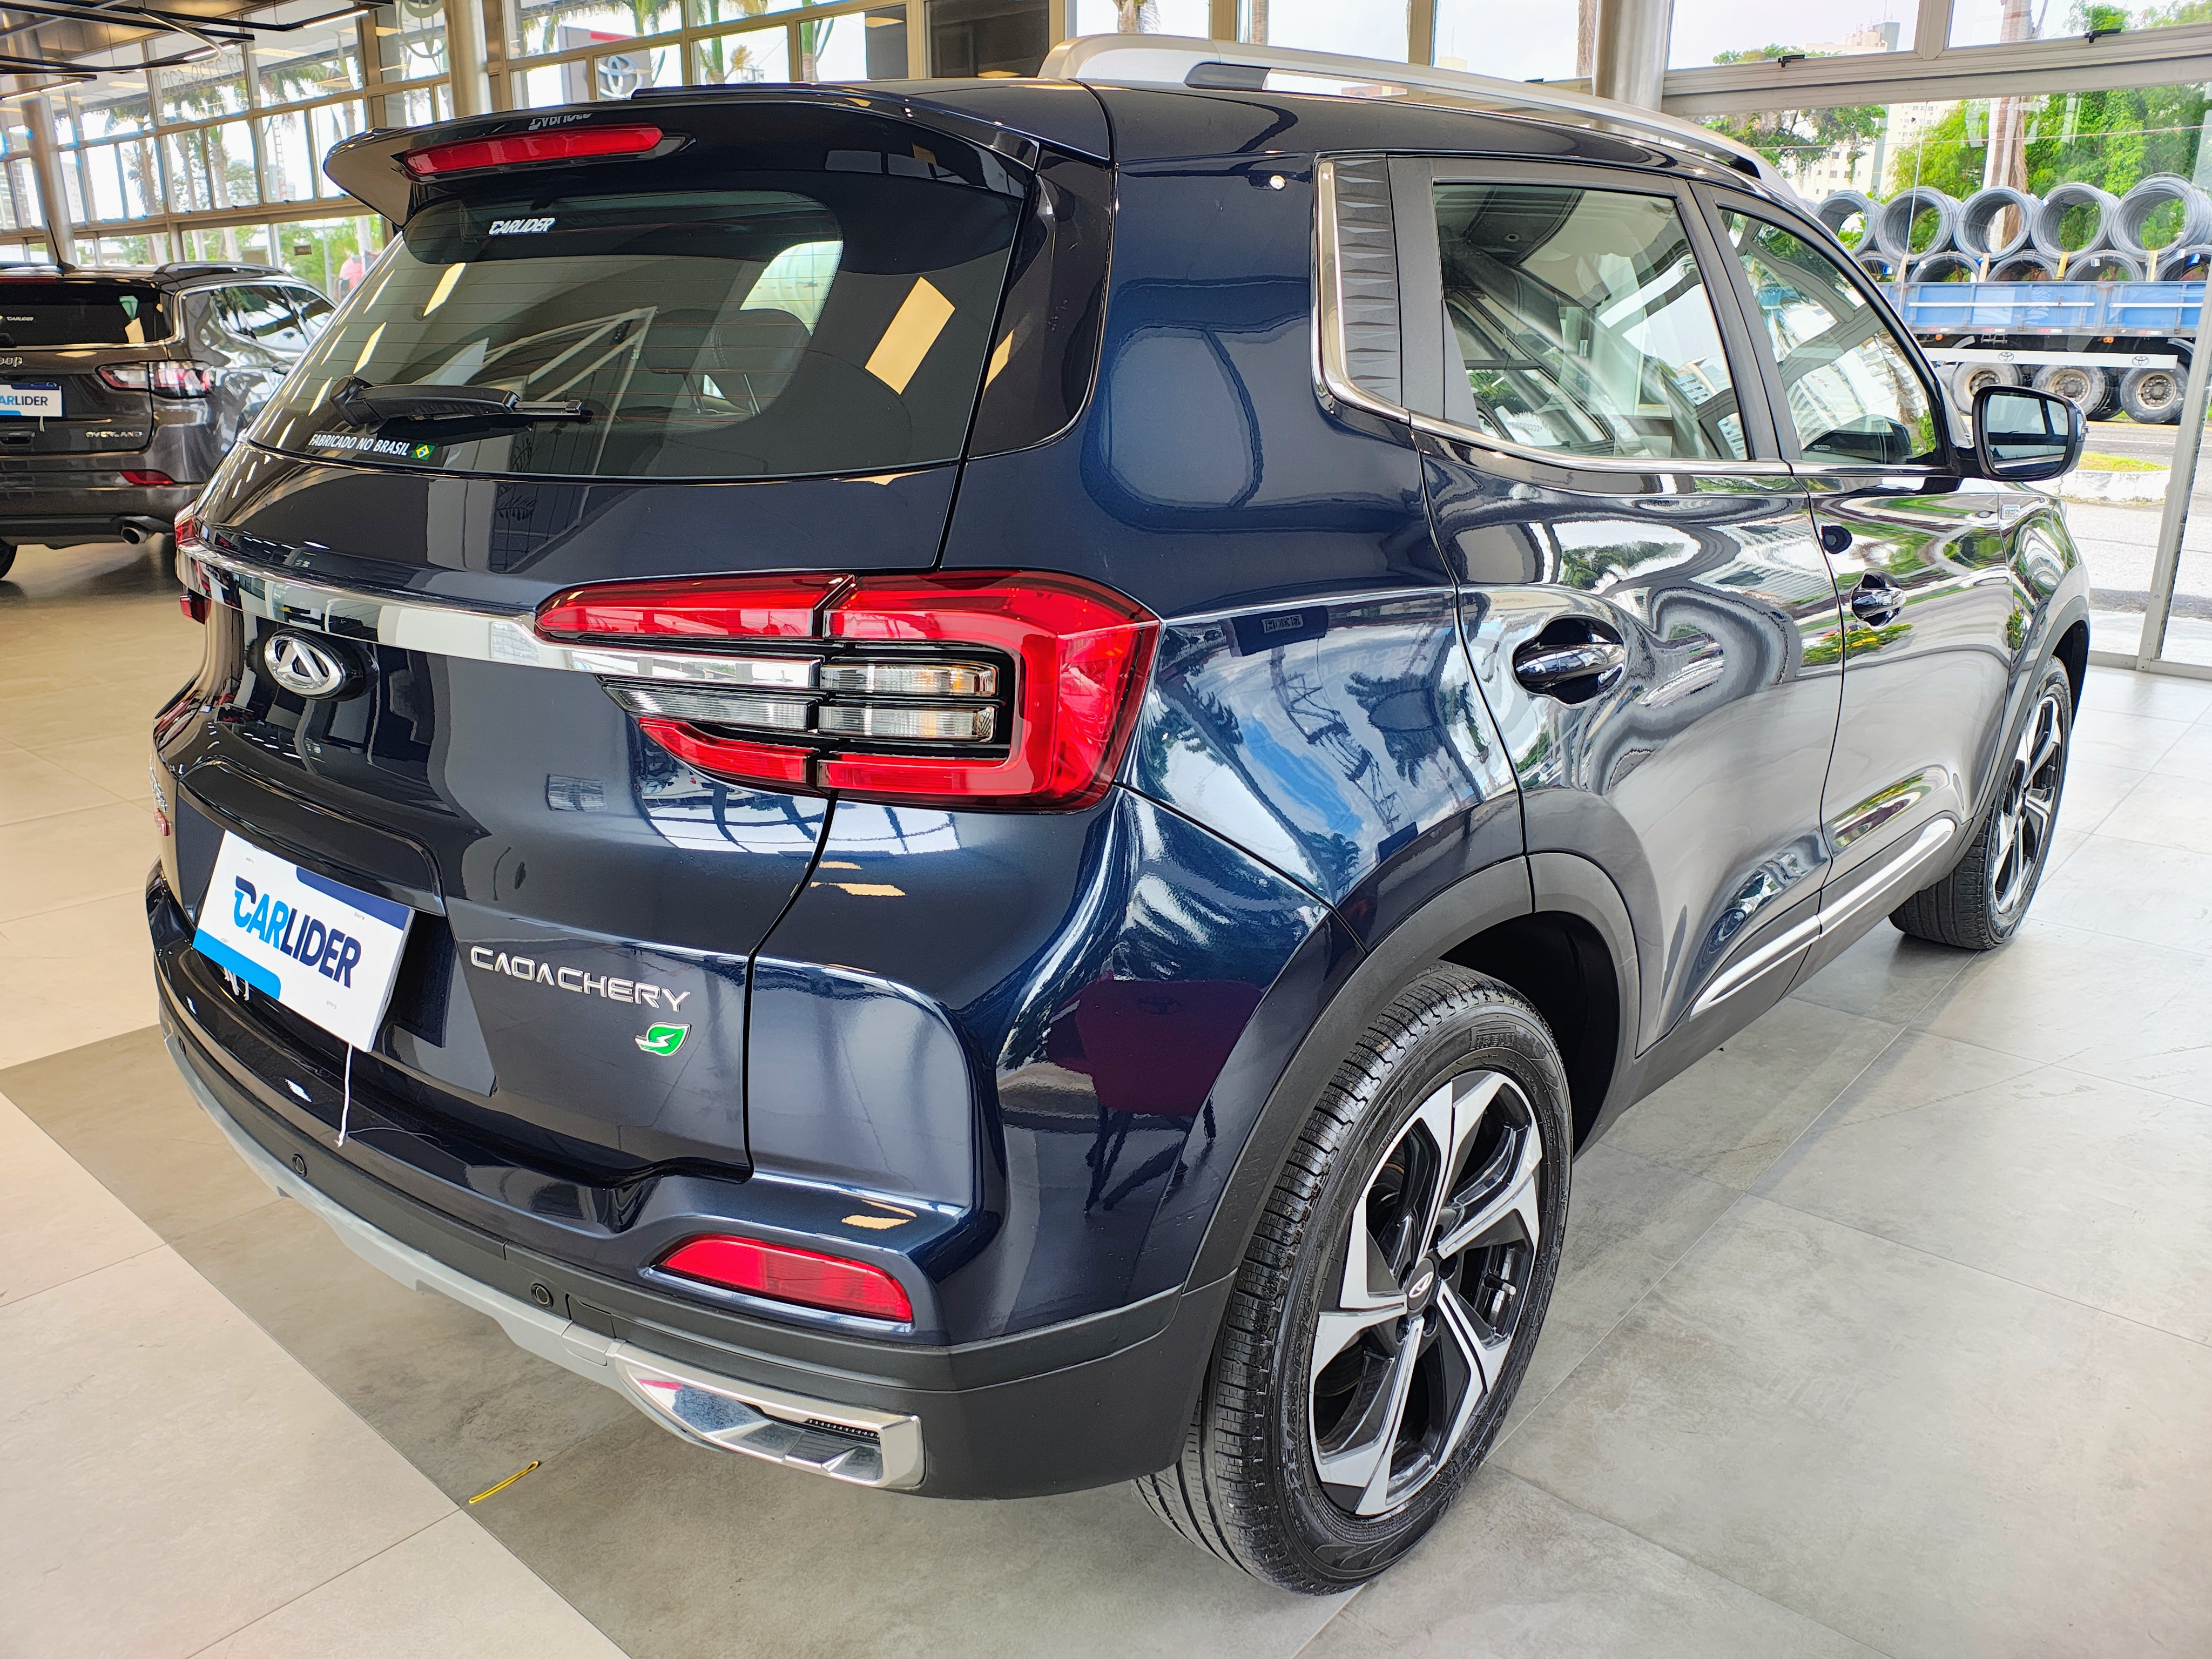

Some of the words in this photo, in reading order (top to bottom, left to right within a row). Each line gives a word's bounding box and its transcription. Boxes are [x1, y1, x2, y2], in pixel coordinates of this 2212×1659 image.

[488, 217, 556, 235] CARLIDER
[0, 356, 22, 368] eep
[0, 395, 48, 406] ARLIDER
[308, 434, 358, 449] FABRICADO
[356, 437, 374, 451] NO
[373, 440, 410, 456] BRASIL
[233, 875, 361, 989] CARLIDER
